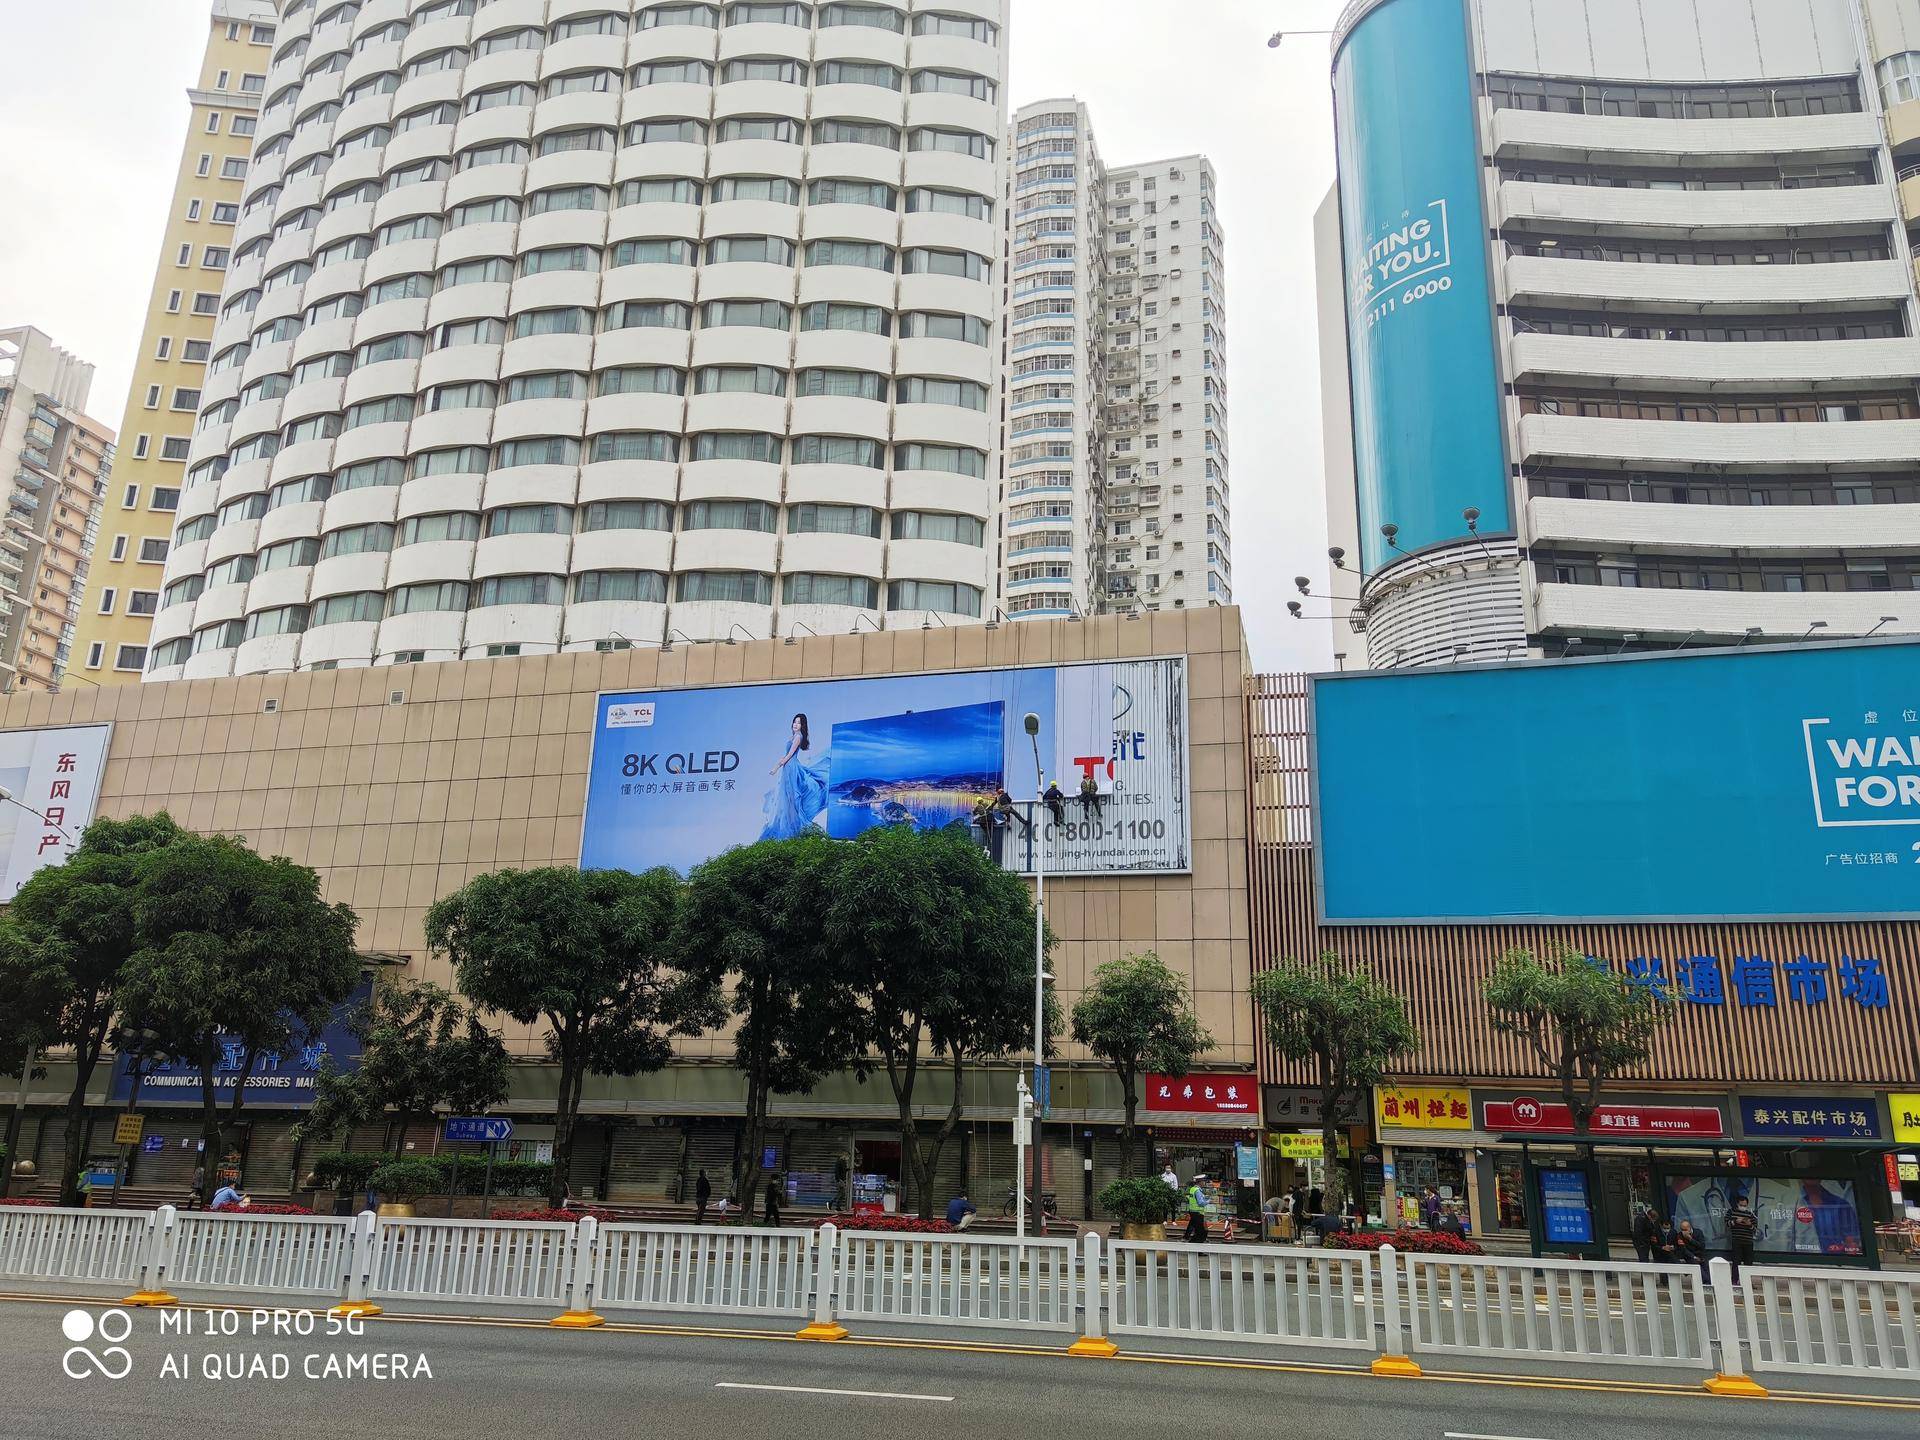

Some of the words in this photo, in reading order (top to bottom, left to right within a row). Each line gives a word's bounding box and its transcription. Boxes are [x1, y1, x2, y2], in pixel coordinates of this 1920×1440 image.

[1378, 241, 1441, 280] YOU.
[1402, 276, 1452, 304] 6000
[621, 753, 659, 777] 8K
[665, 750, 740, 776] QLED
[620, 779, 736, 796] 懂你的大屏音画专家
[38, 752, 77, 856] 东风日产
[1825, 852, 1898, 866] 广告位招商
[224, 1076, 291, 1088] ACESSORIES
[1600, 1114, 1640, 1127] 美宜佳
[1753, 1108, 1867, 1127] 泰兴配件市场
[1852, 1128, 1873, 1137] 入口
